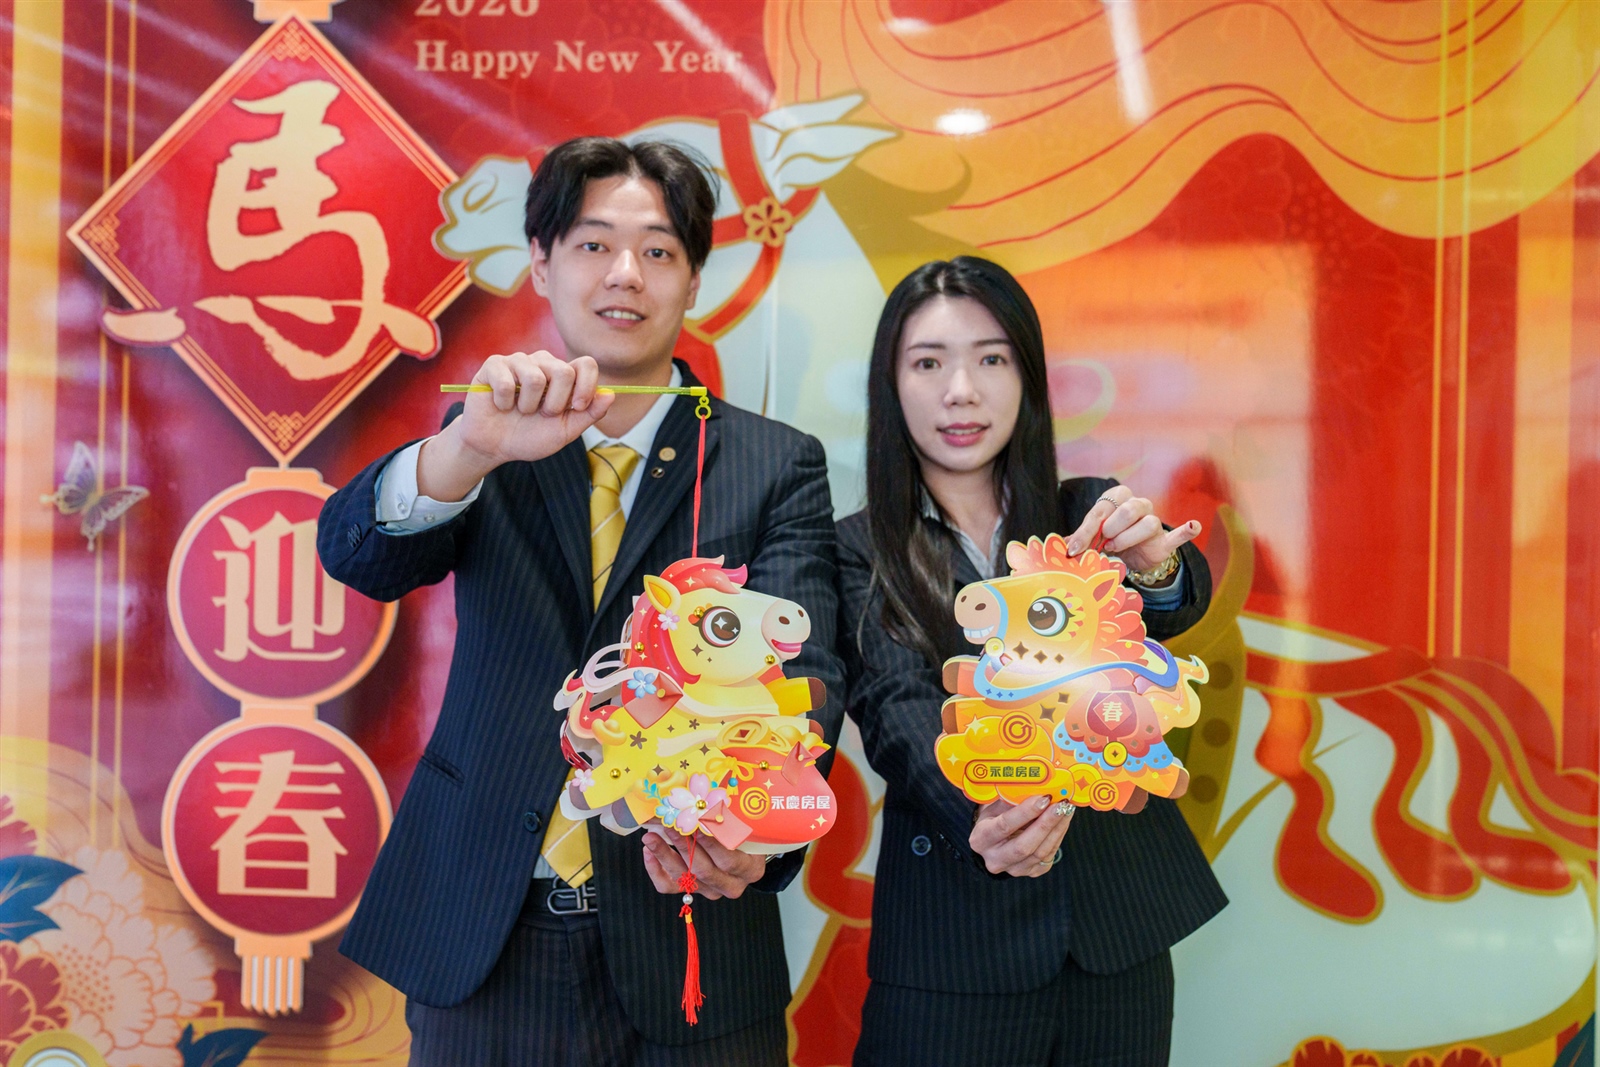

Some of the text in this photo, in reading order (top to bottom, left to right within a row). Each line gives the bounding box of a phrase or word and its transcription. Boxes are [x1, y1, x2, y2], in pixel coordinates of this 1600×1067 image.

[414, 40, 743, 79] Happy New Year
[1102, 701, 1123, 722] 春
[990, 766, 1040, 777] 永慶房屋
[771, 795, 831, 810] 永慶房屋
